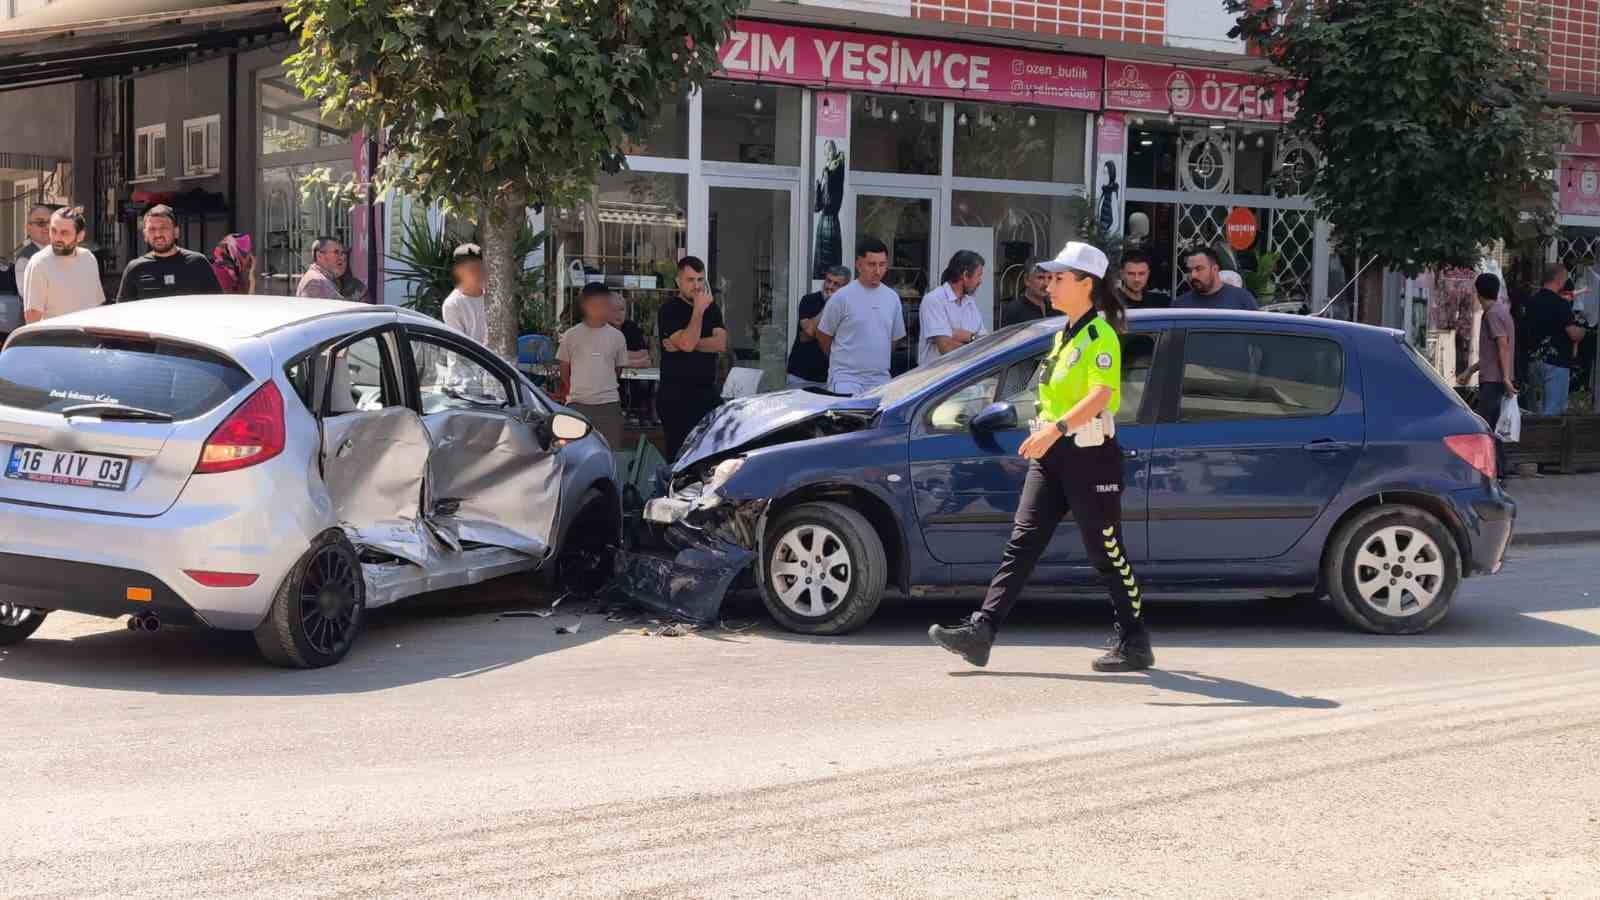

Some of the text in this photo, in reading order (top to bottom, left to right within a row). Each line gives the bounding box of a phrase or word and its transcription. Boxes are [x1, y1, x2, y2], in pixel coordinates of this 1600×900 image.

[722, 31, 991, 90] ZIM YEŞİM'CE
[1201, 72, 1274, 116] ÖZEN
[23, 450, 123, 482] 16 KIV 03
